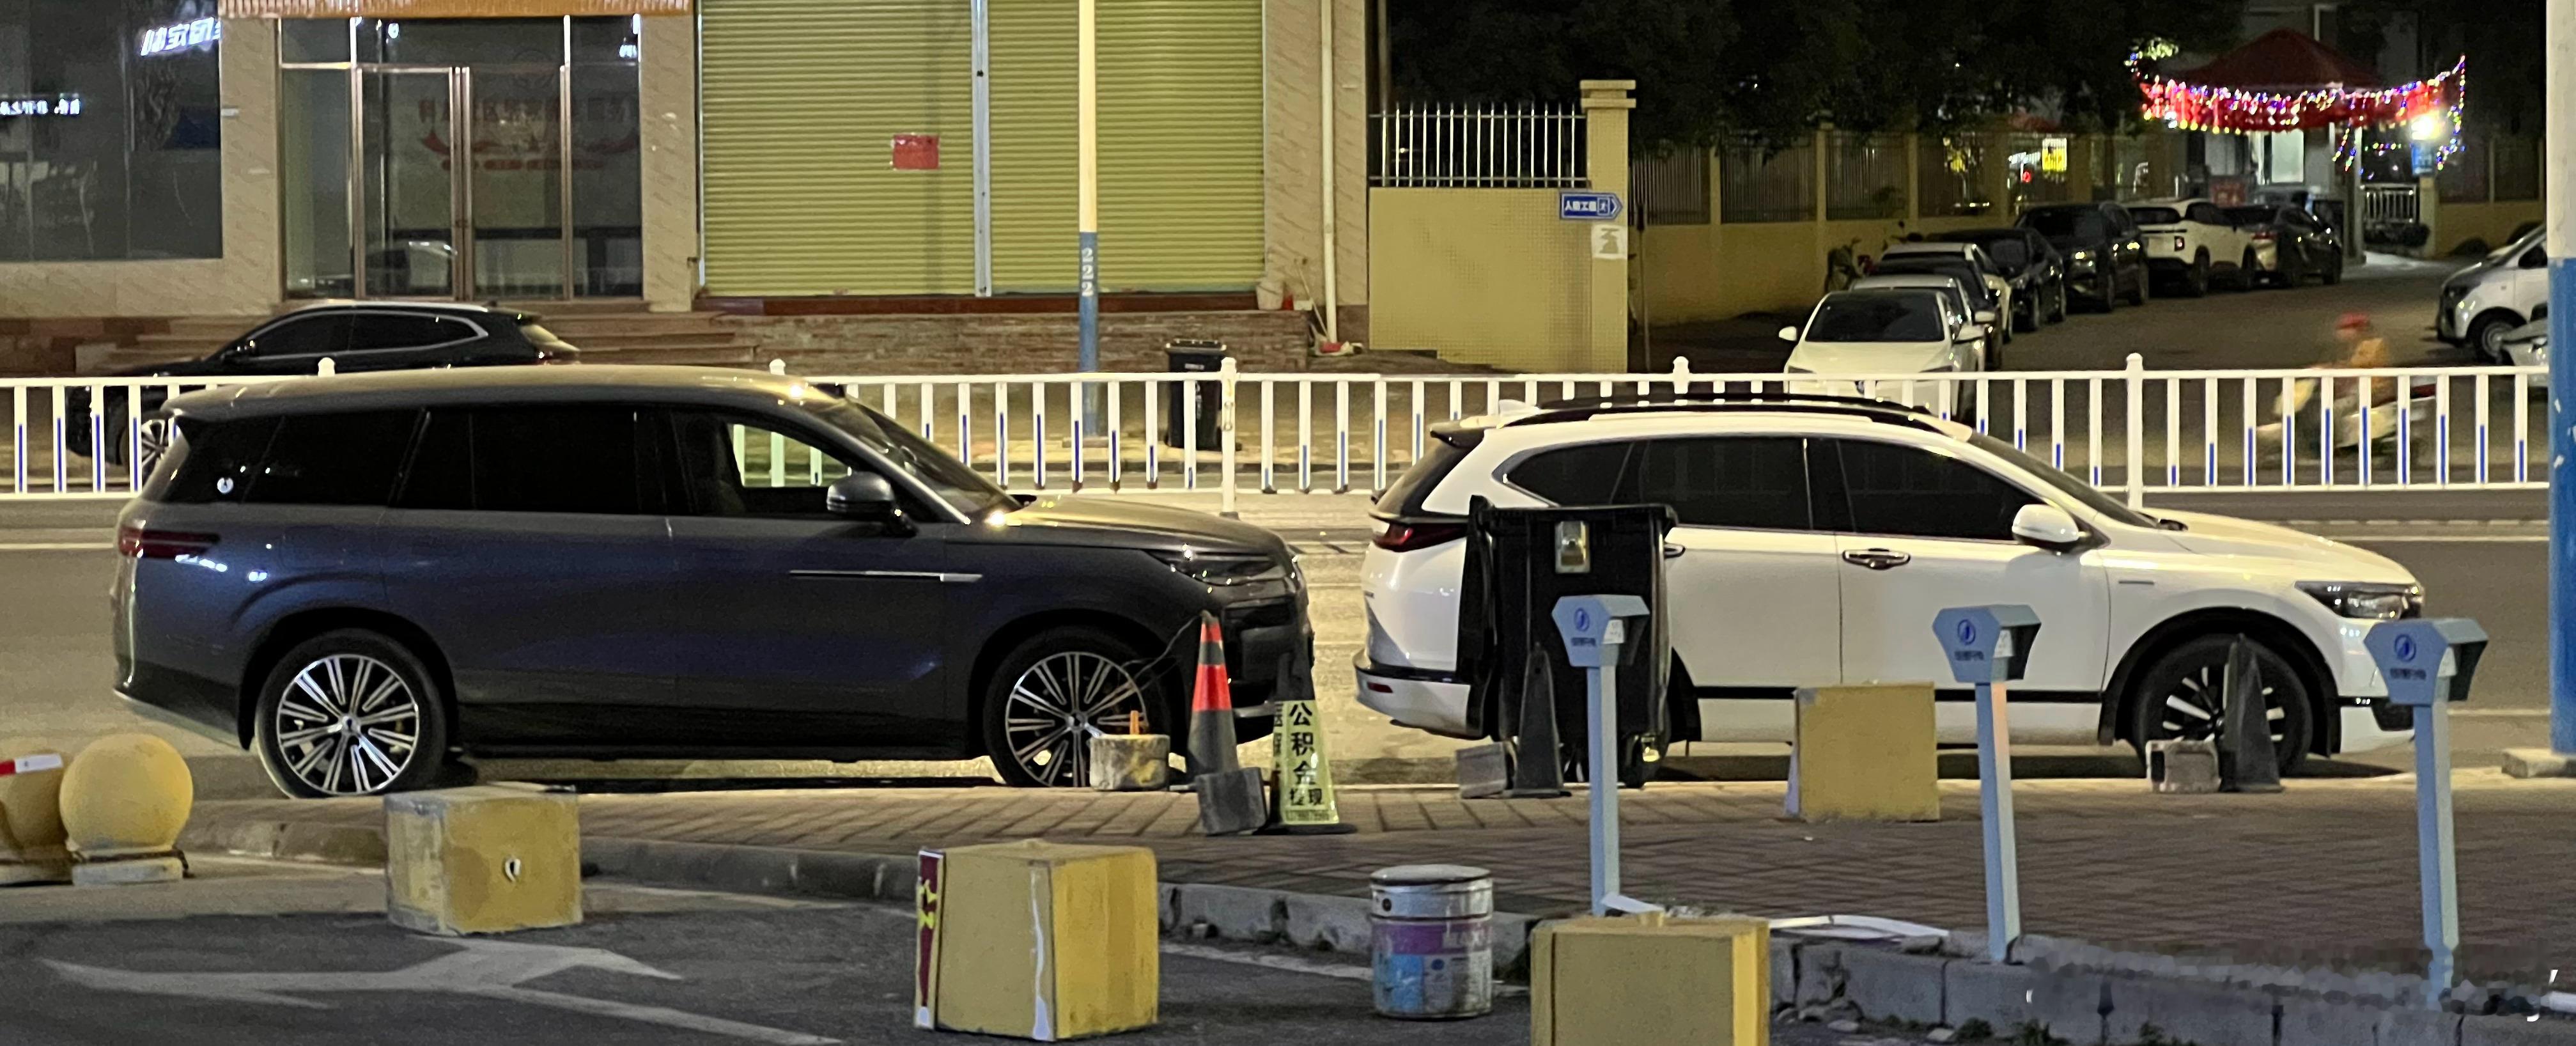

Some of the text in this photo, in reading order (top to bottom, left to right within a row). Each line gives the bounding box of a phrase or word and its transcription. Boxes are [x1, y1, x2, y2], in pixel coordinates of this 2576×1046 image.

[1082, 247, 1094, 297] 222
[1289, 702, 1315, 785] 公积金
